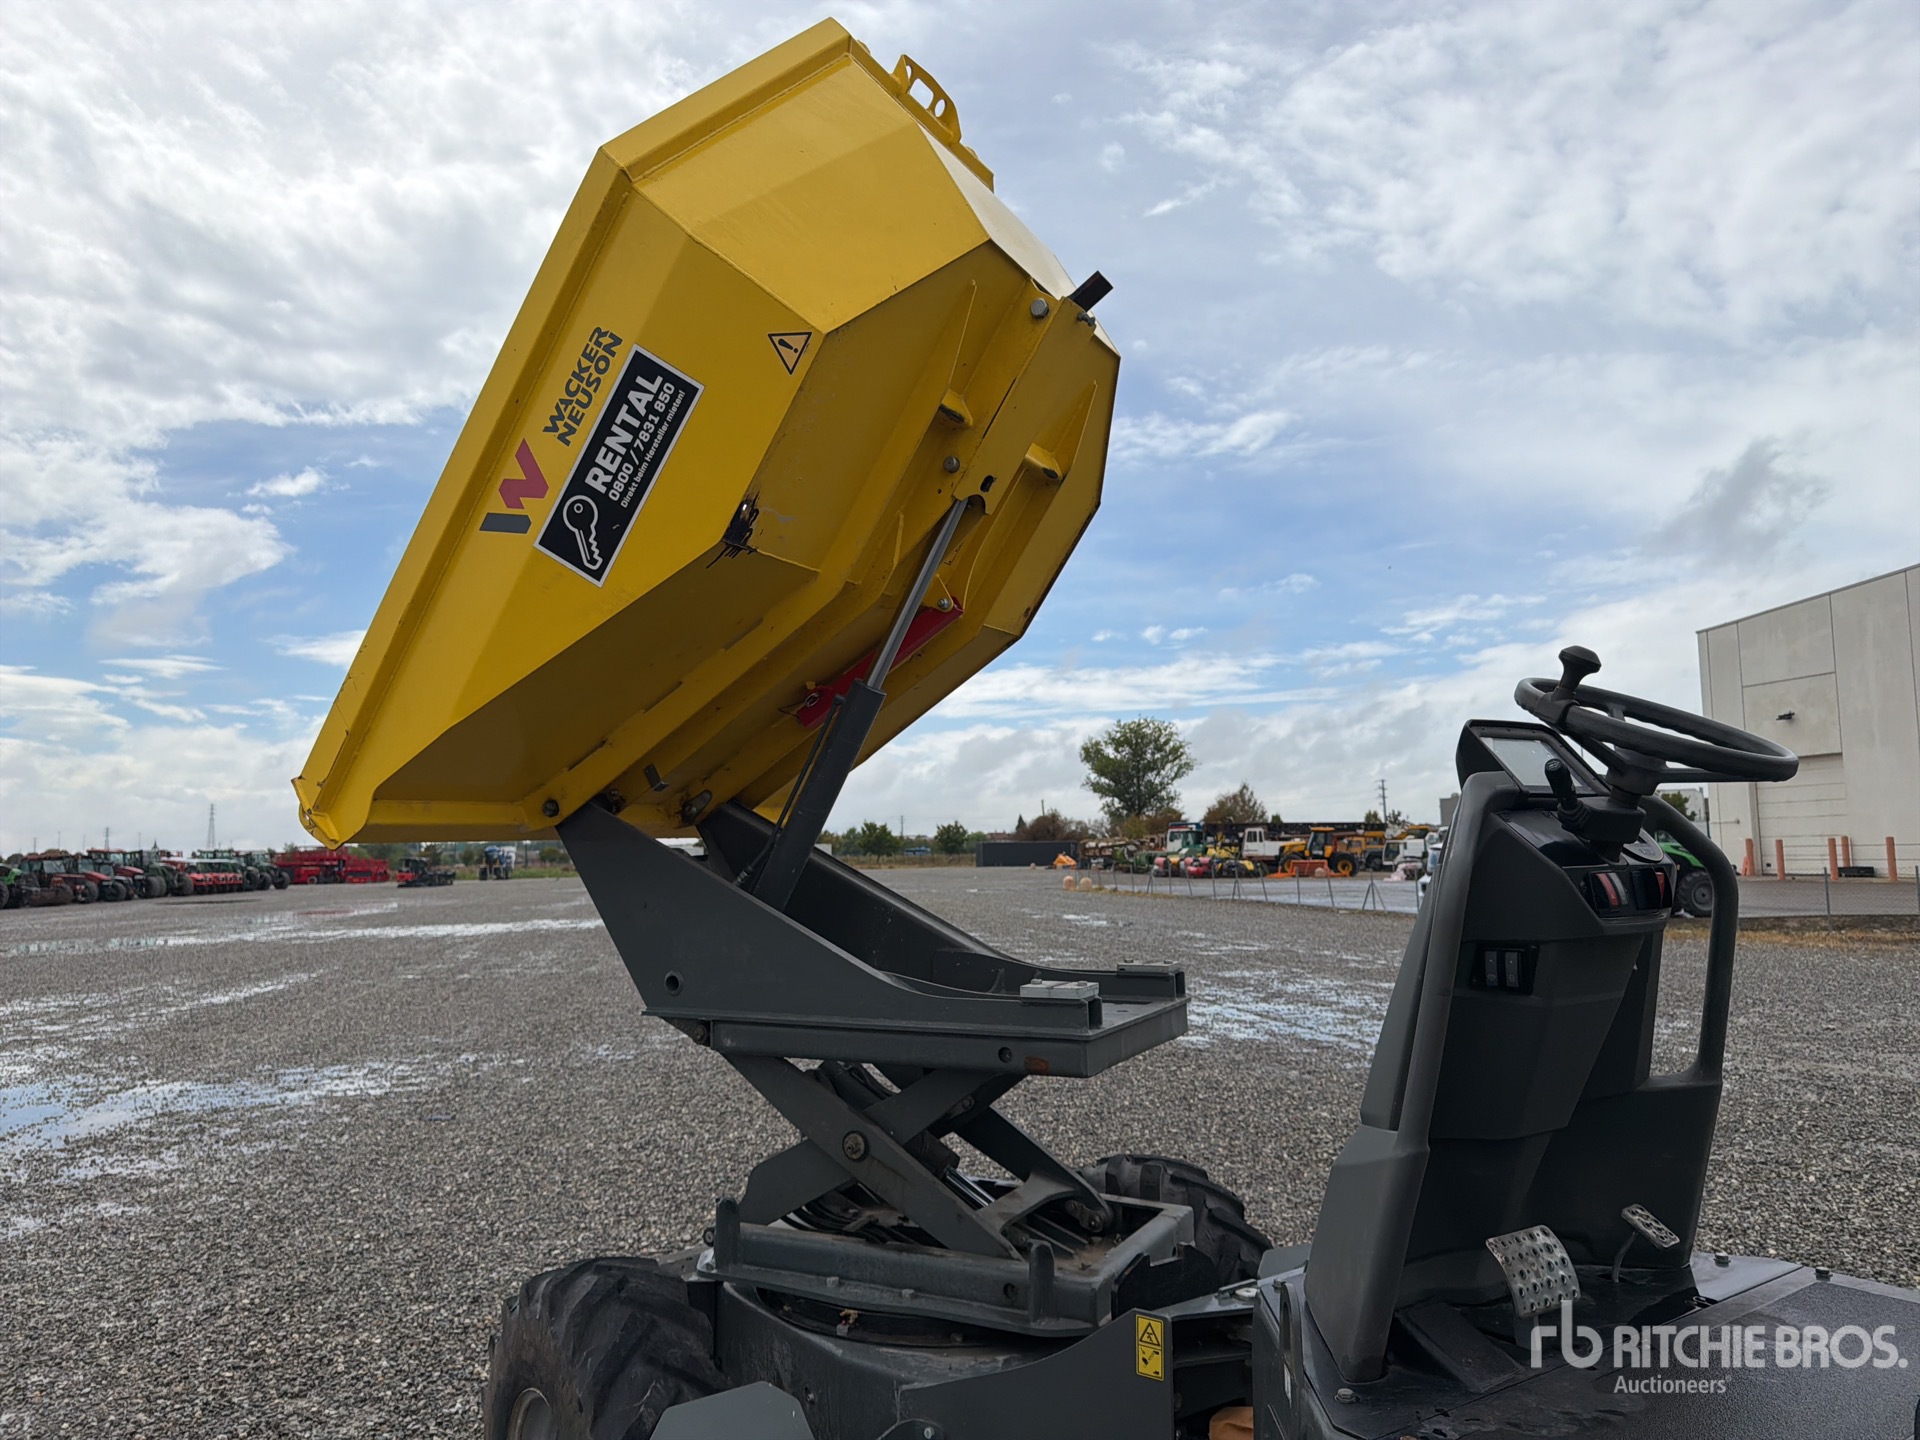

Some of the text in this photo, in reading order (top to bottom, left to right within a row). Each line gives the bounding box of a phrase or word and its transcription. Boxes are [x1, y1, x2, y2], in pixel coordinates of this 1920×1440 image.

[542, 327, 609, 433] WACKER
[557, 332, 623, 447] NEUSON
[584, 375, 664, 494] RENTAL
[608, 382, 675, 501] 0800 / 7831 850
[620, 389, 686, 509] Direkt beim Hersteller mieten!
